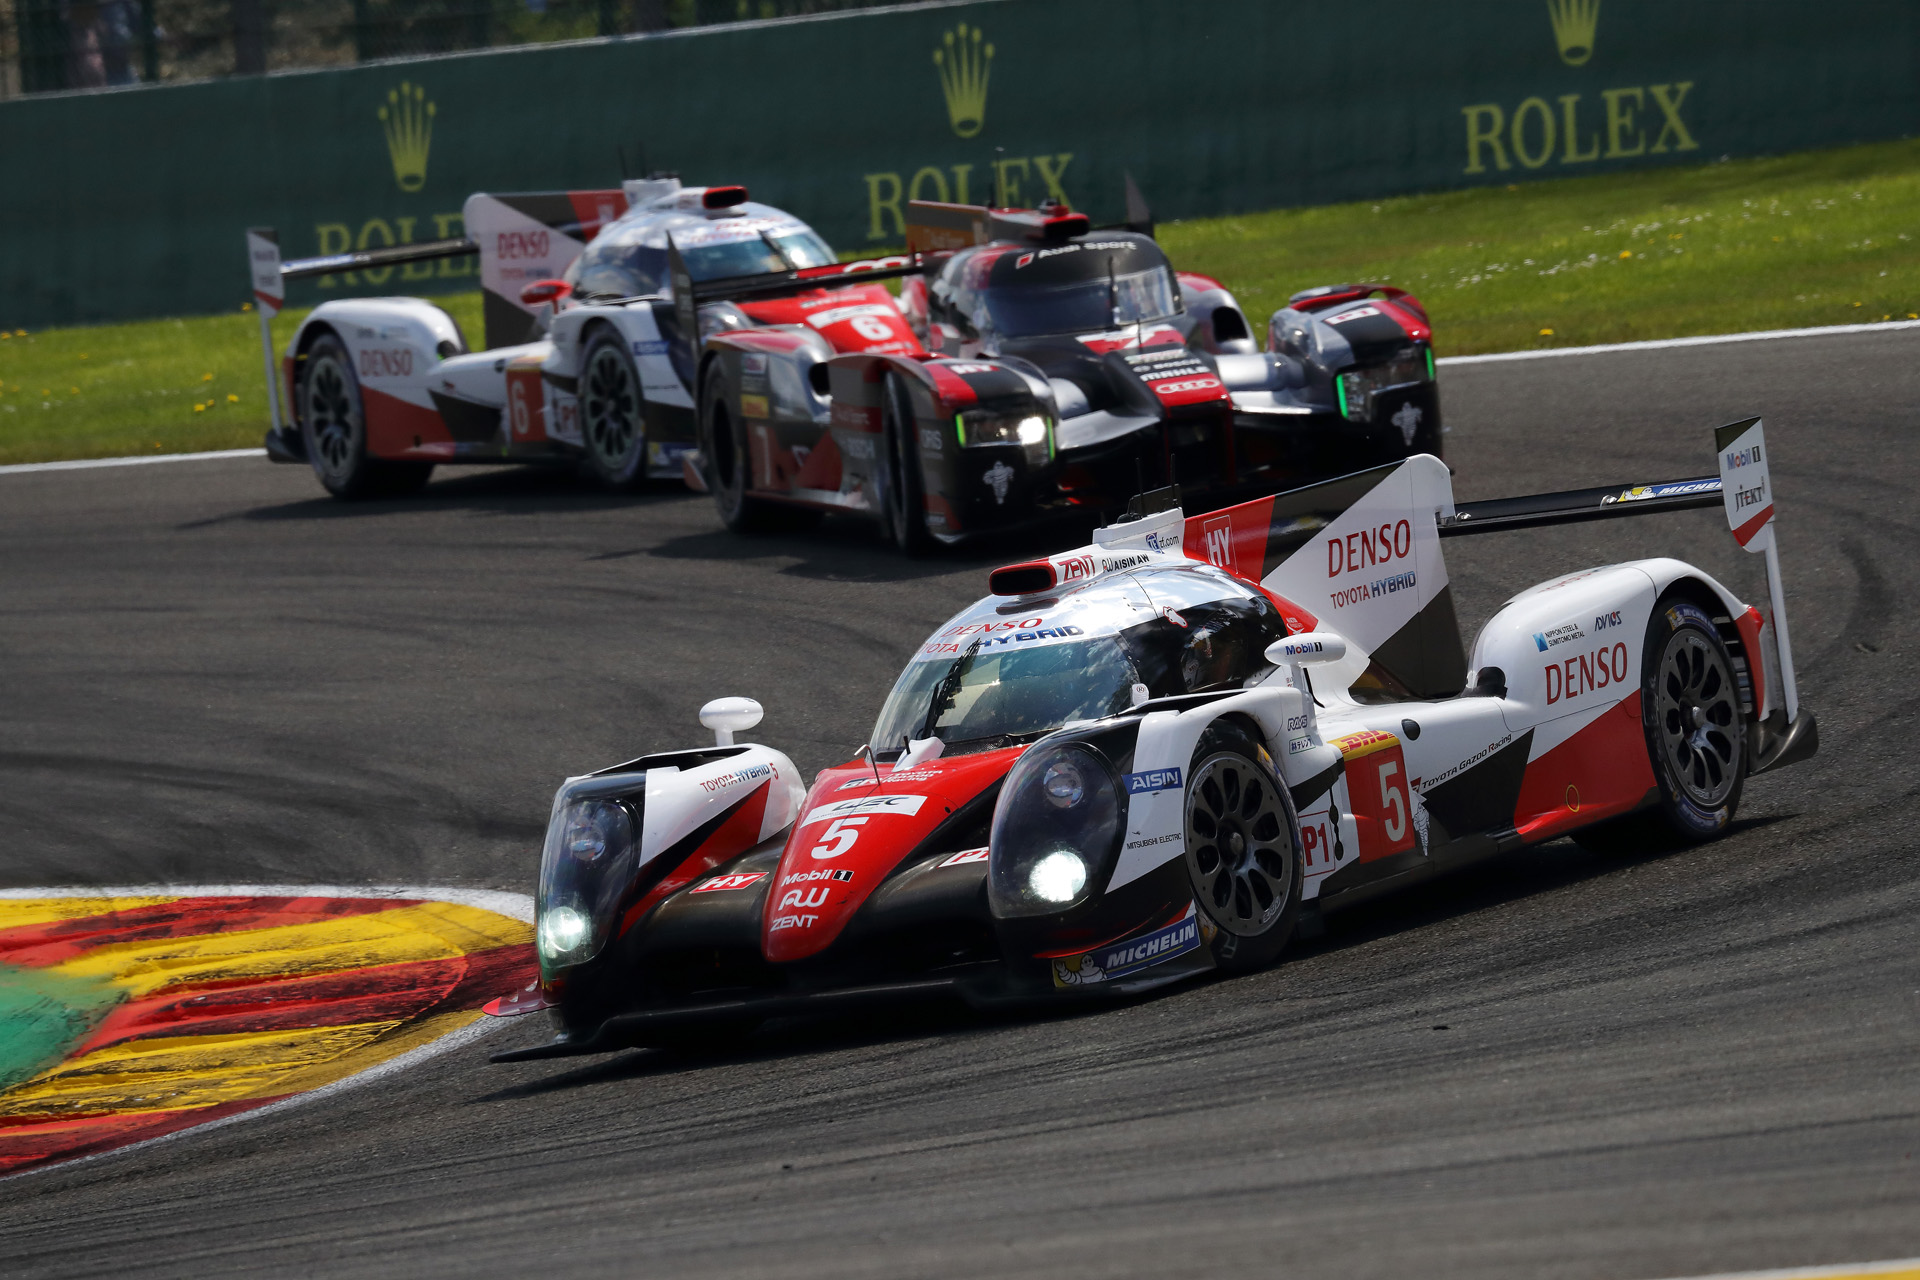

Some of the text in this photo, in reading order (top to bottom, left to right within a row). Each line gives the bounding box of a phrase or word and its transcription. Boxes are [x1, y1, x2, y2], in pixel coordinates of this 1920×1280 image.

[1462, 81, 1699, 174] ROLEX
[497, 230, 549, 259] DENSO
[1038, 241, 1137, 259] Audi Sport
[851, 315, 894, 341] 6
[360, 348, 412, 377] DENSO
[511, 380, 529, 435] 6
[1726, 448, 1751, 471] Mobil
[1735, 486, 1762, 512] JTEKT
[1206, 526, 1231, 568] HY
[1327, 519, 1411, 579] DENSO
[1058, 555, 1096, 585] ZENT
[1114, 553, 1150, 572] AISIN AW
[1330, 571, 1417, 610] TOYOTA HYBRID
[941, 618, 1043, 638] DENSO
[979, 625, 1085, 648] HYBRID
[1285, 643, 1314, 655] Mobil
[1545, 642, 1628, 705] DENSO
[1340, 730, 1389, 751] DHL
[1422, 766, 1458, 788] TOYOTA
[1459, 749, 1488, 771] GAZOO
[1488, 734, 1512, 753] Racing
[700, 762, 779, 792] TOYOTA HYBRID 5
[1132, 771, 1178, 790] AISIN
[1378, 760, 1406, 842] 5
[810, 816, 870, 860] 5
[1126, 833, 1182, 850] MITSUBISHI ELECTRIC
[1304, 822, 1330, 867] P1
[698, 875, 761, 890] HY
[781, 869, 833, 887] Mobil
[769, 914, 819, 933] ZENT
[1106, 922, 1195, 968] MICHELIN
